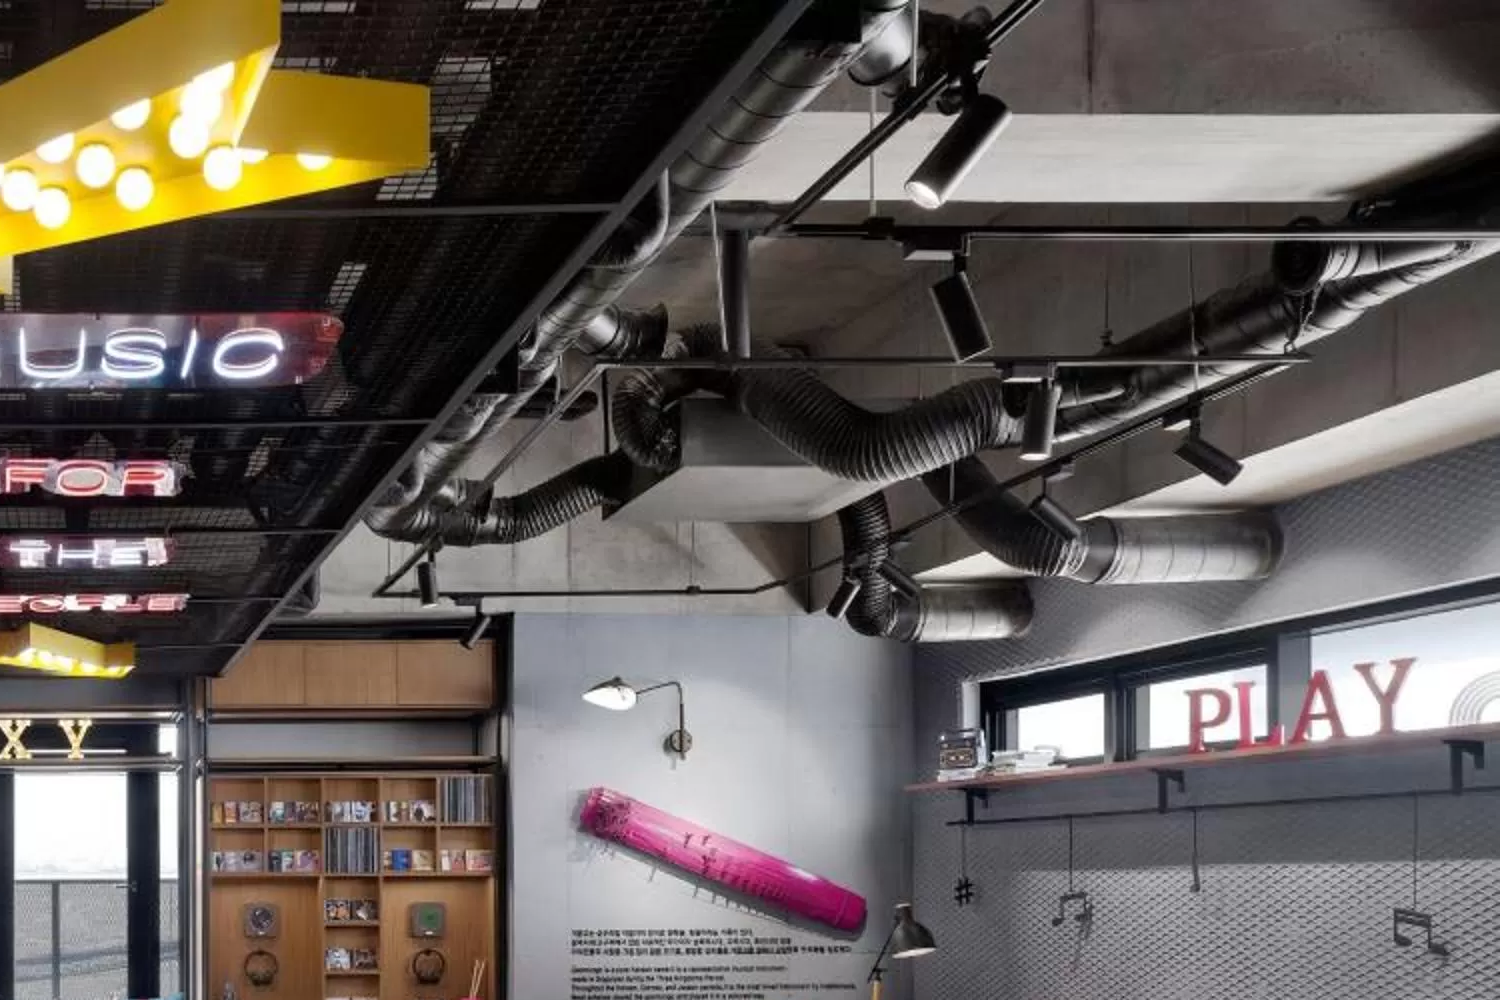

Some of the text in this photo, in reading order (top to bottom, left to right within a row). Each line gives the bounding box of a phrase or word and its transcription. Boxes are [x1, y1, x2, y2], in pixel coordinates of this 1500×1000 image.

[2, 458, 174, 497] FOR
[9, 538, 150, 567] THE
[1183, 656, 1418, 754] PLAY
